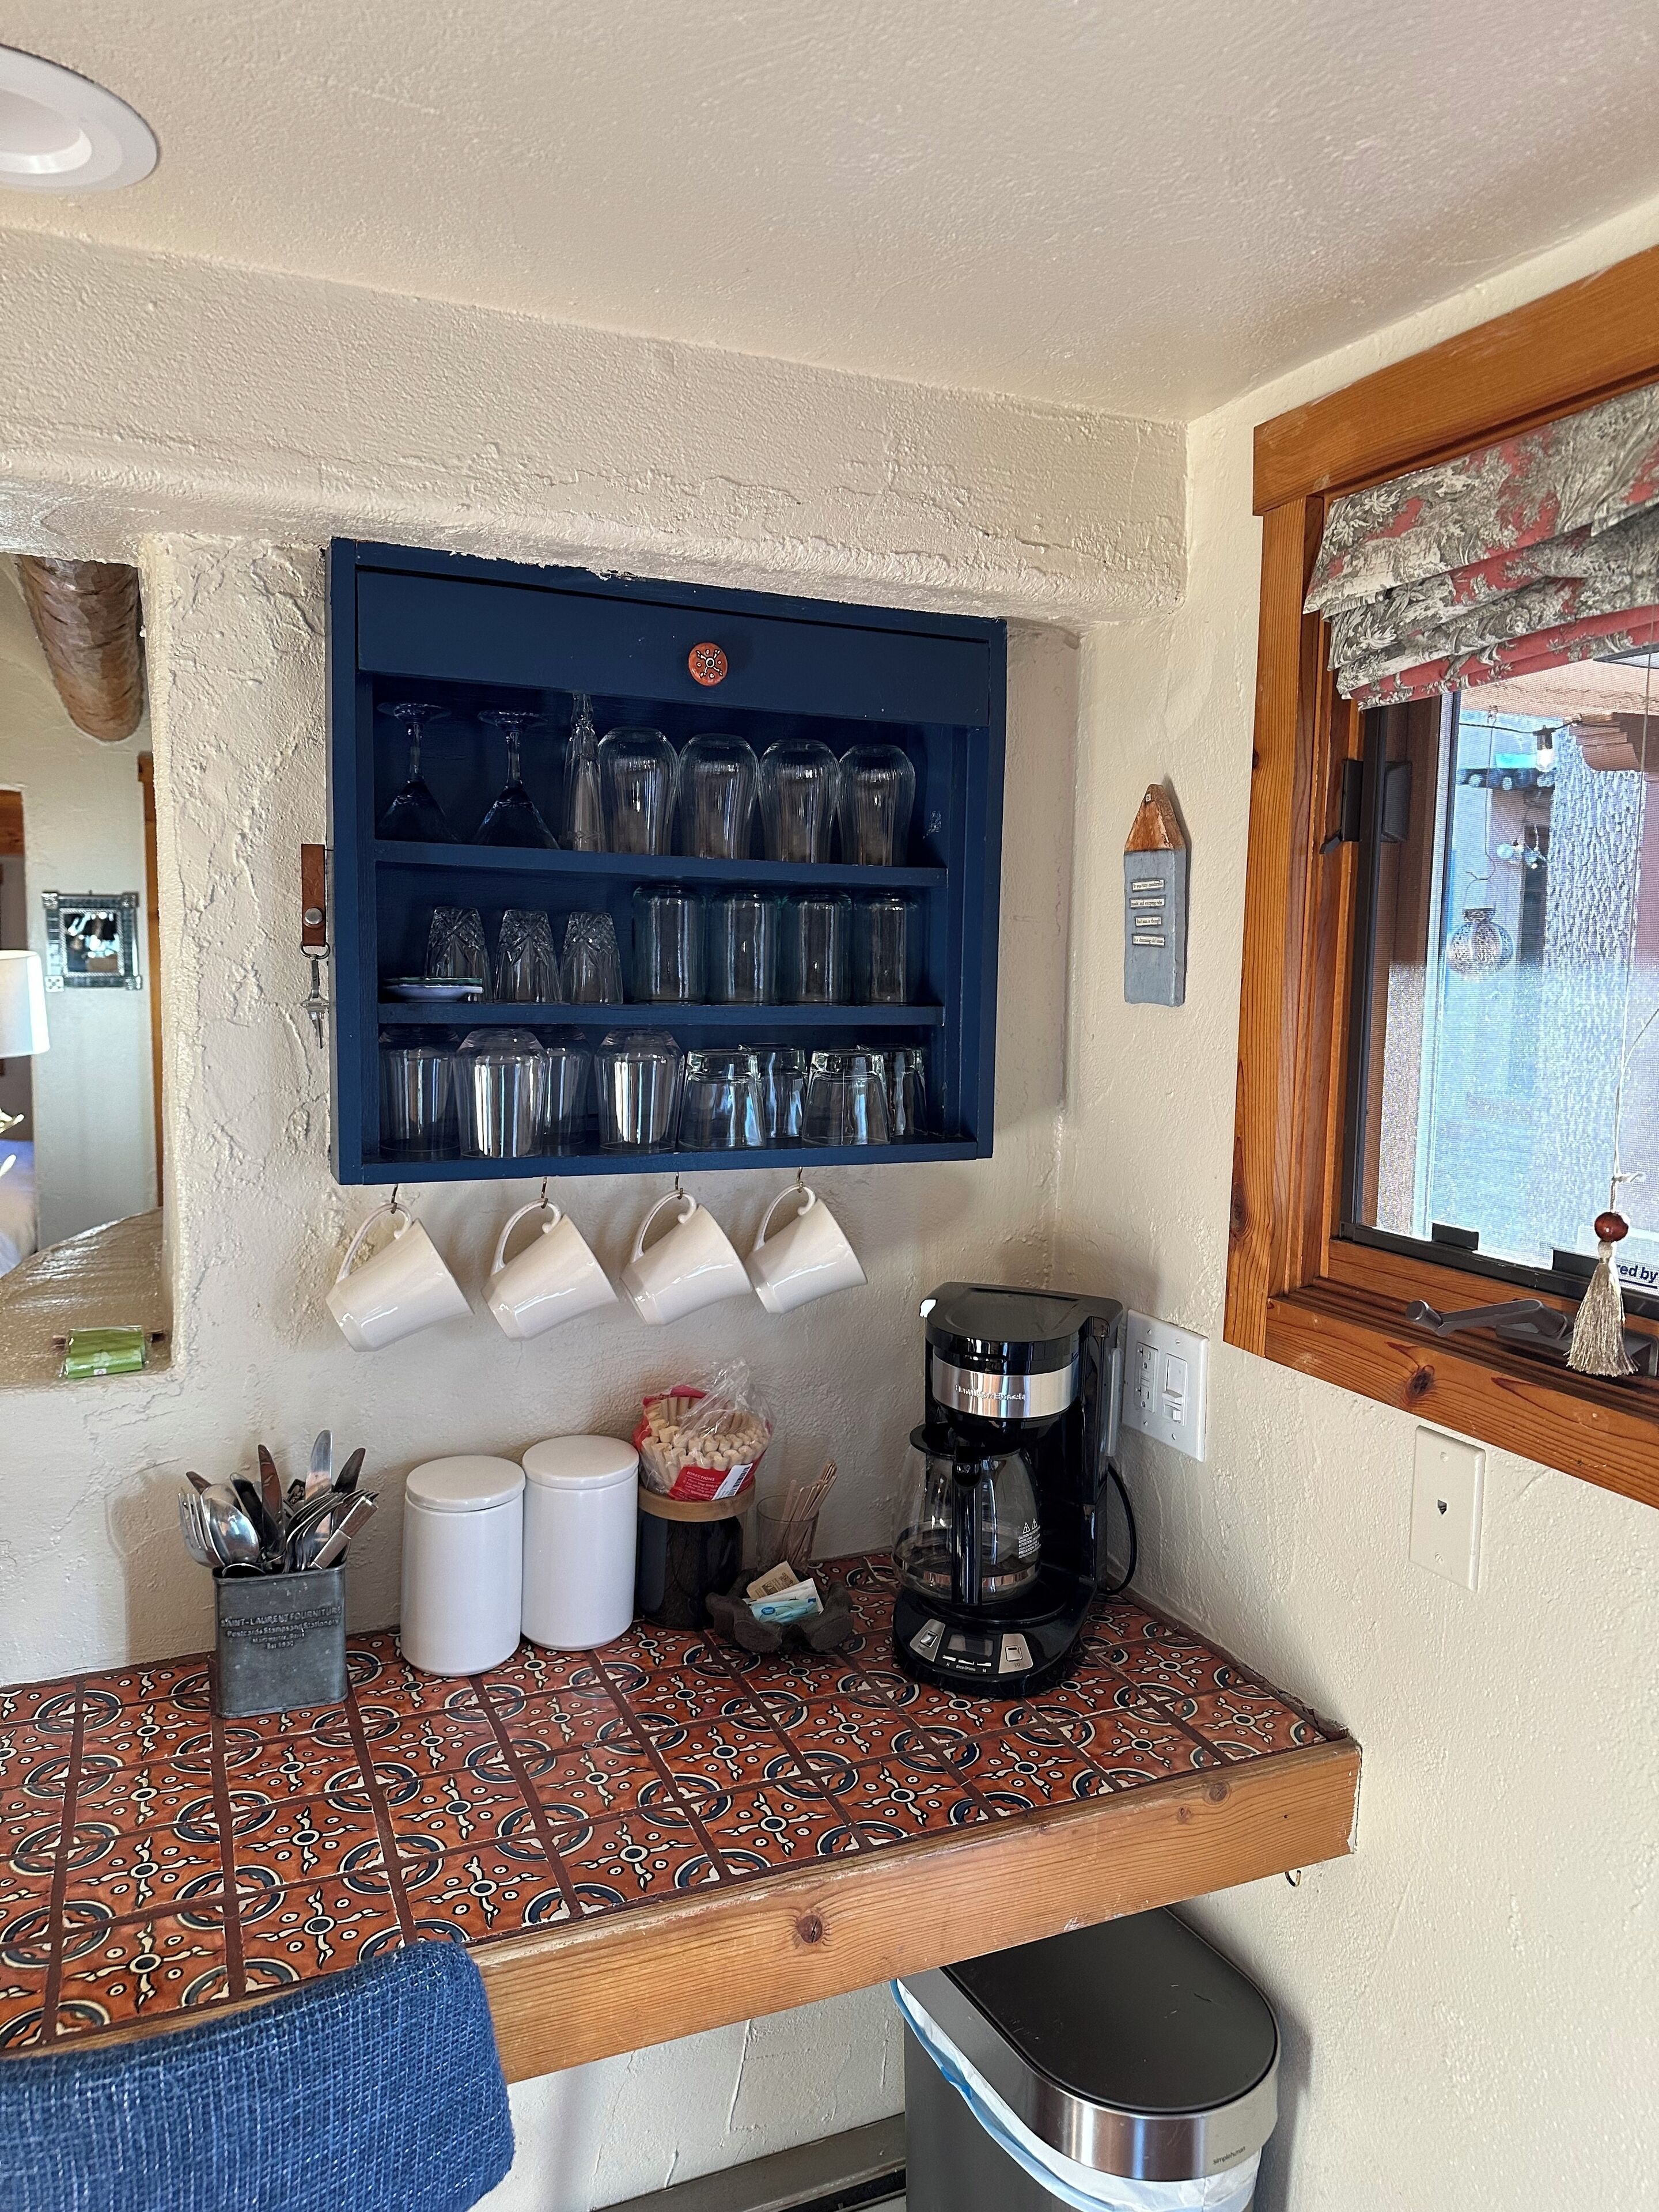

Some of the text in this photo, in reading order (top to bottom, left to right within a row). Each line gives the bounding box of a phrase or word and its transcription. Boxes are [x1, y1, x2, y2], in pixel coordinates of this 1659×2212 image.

[1639, 1267, 1658, 1283] by
[687, 1471, 715, 1482] DIRECTIONS
[289, 1605, 342, 1620] FOURNITURE
[1213, 2146, 1246, 2165] simplehuman
